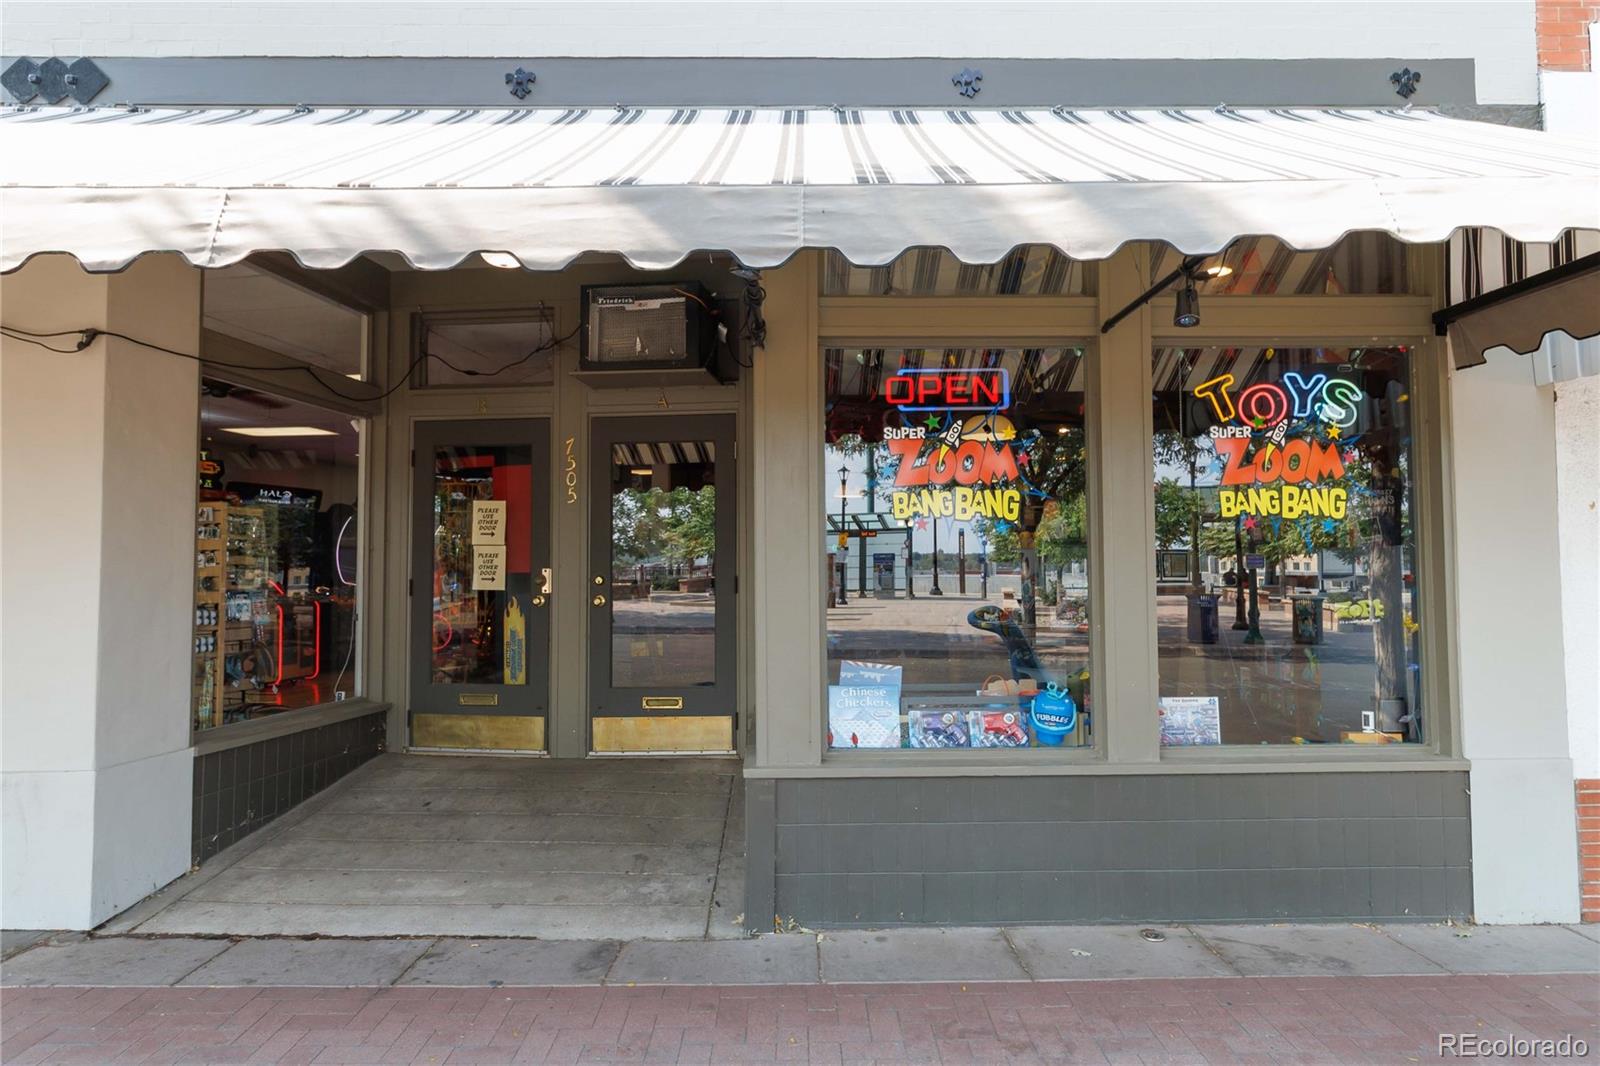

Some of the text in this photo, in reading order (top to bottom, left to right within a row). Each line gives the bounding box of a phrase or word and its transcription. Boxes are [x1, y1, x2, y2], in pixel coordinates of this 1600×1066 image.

[598, 297, 633, 305] Friedrich
[657, 392, 669, 409] A
[885, 375, 999, 404] OPEN
[1194, 373, 1363, 428] TOYS
[884, 427, 926, 440] SUPER
[1210, 426, 1252, 439] SUPER
[888, 438, 1019, 488] ZOOM
[1214, 438, 1345, 486] ZOOM
[260, 488, 293, 500] HALO
[893, 486, 1021, 522] BANG BANG
[1219, 485, 1347, 520] BANG BANG
[840, 687, 888, 697] Chinese
